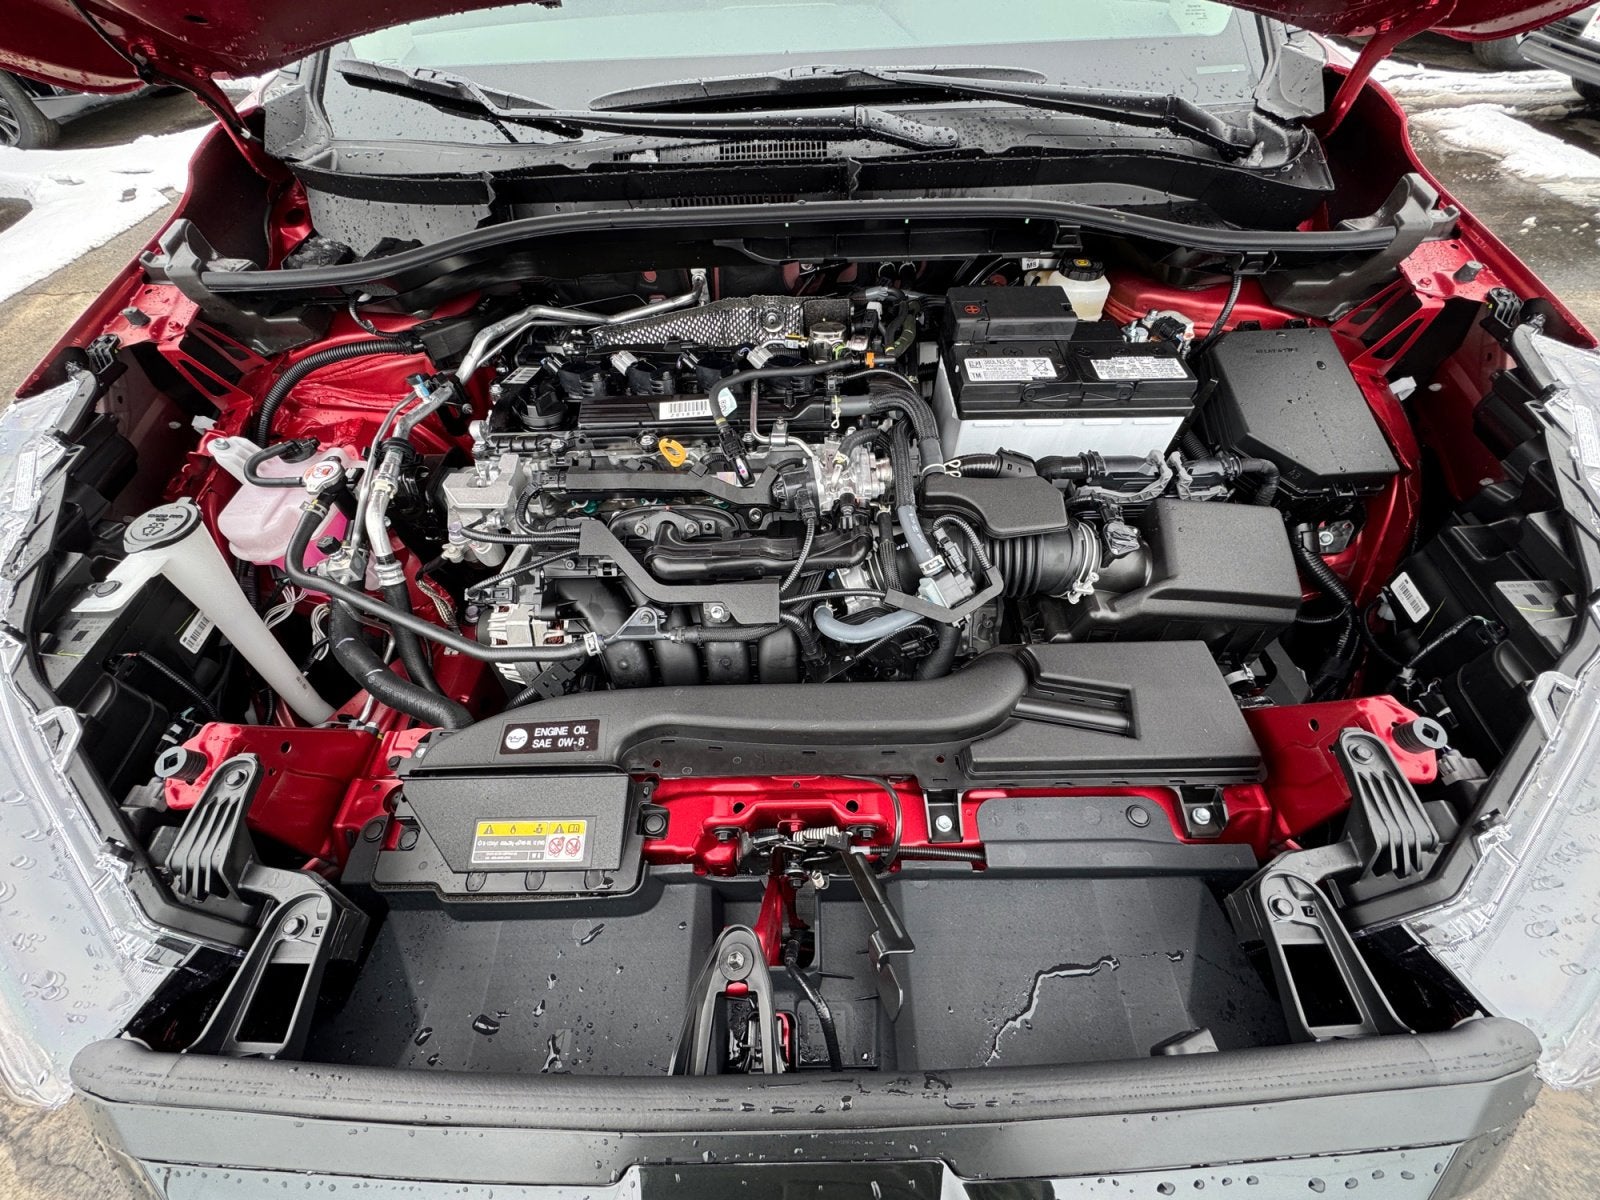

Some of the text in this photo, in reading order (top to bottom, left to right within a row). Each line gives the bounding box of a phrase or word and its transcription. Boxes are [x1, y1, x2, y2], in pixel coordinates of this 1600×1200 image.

[534, 725, 589, 737] ENGINE OIL
[532, 737, 585, 749] SAE 0W-8
